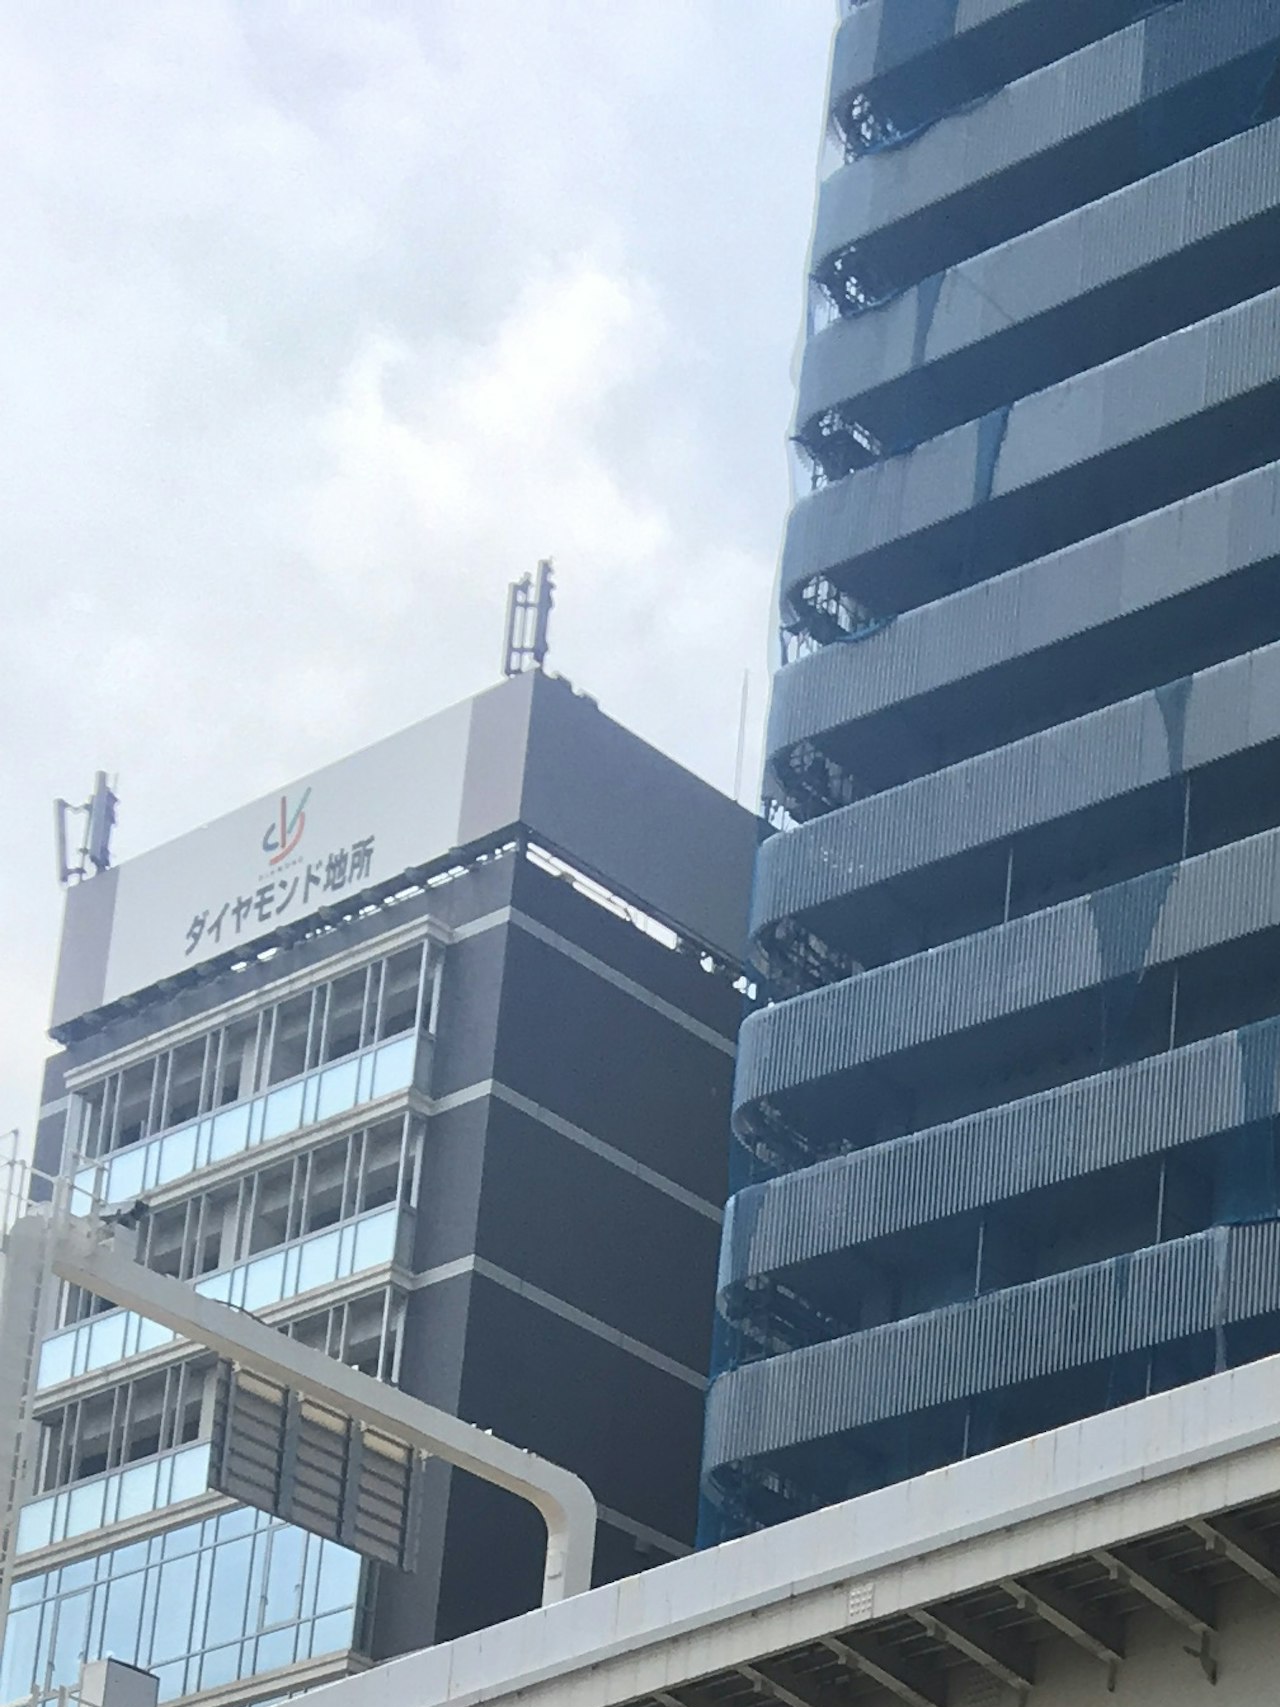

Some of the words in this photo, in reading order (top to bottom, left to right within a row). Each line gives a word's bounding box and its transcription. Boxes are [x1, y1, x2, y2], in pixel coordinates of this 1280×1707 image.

[184, 834, 376, 956] ダイヤモンド地所
